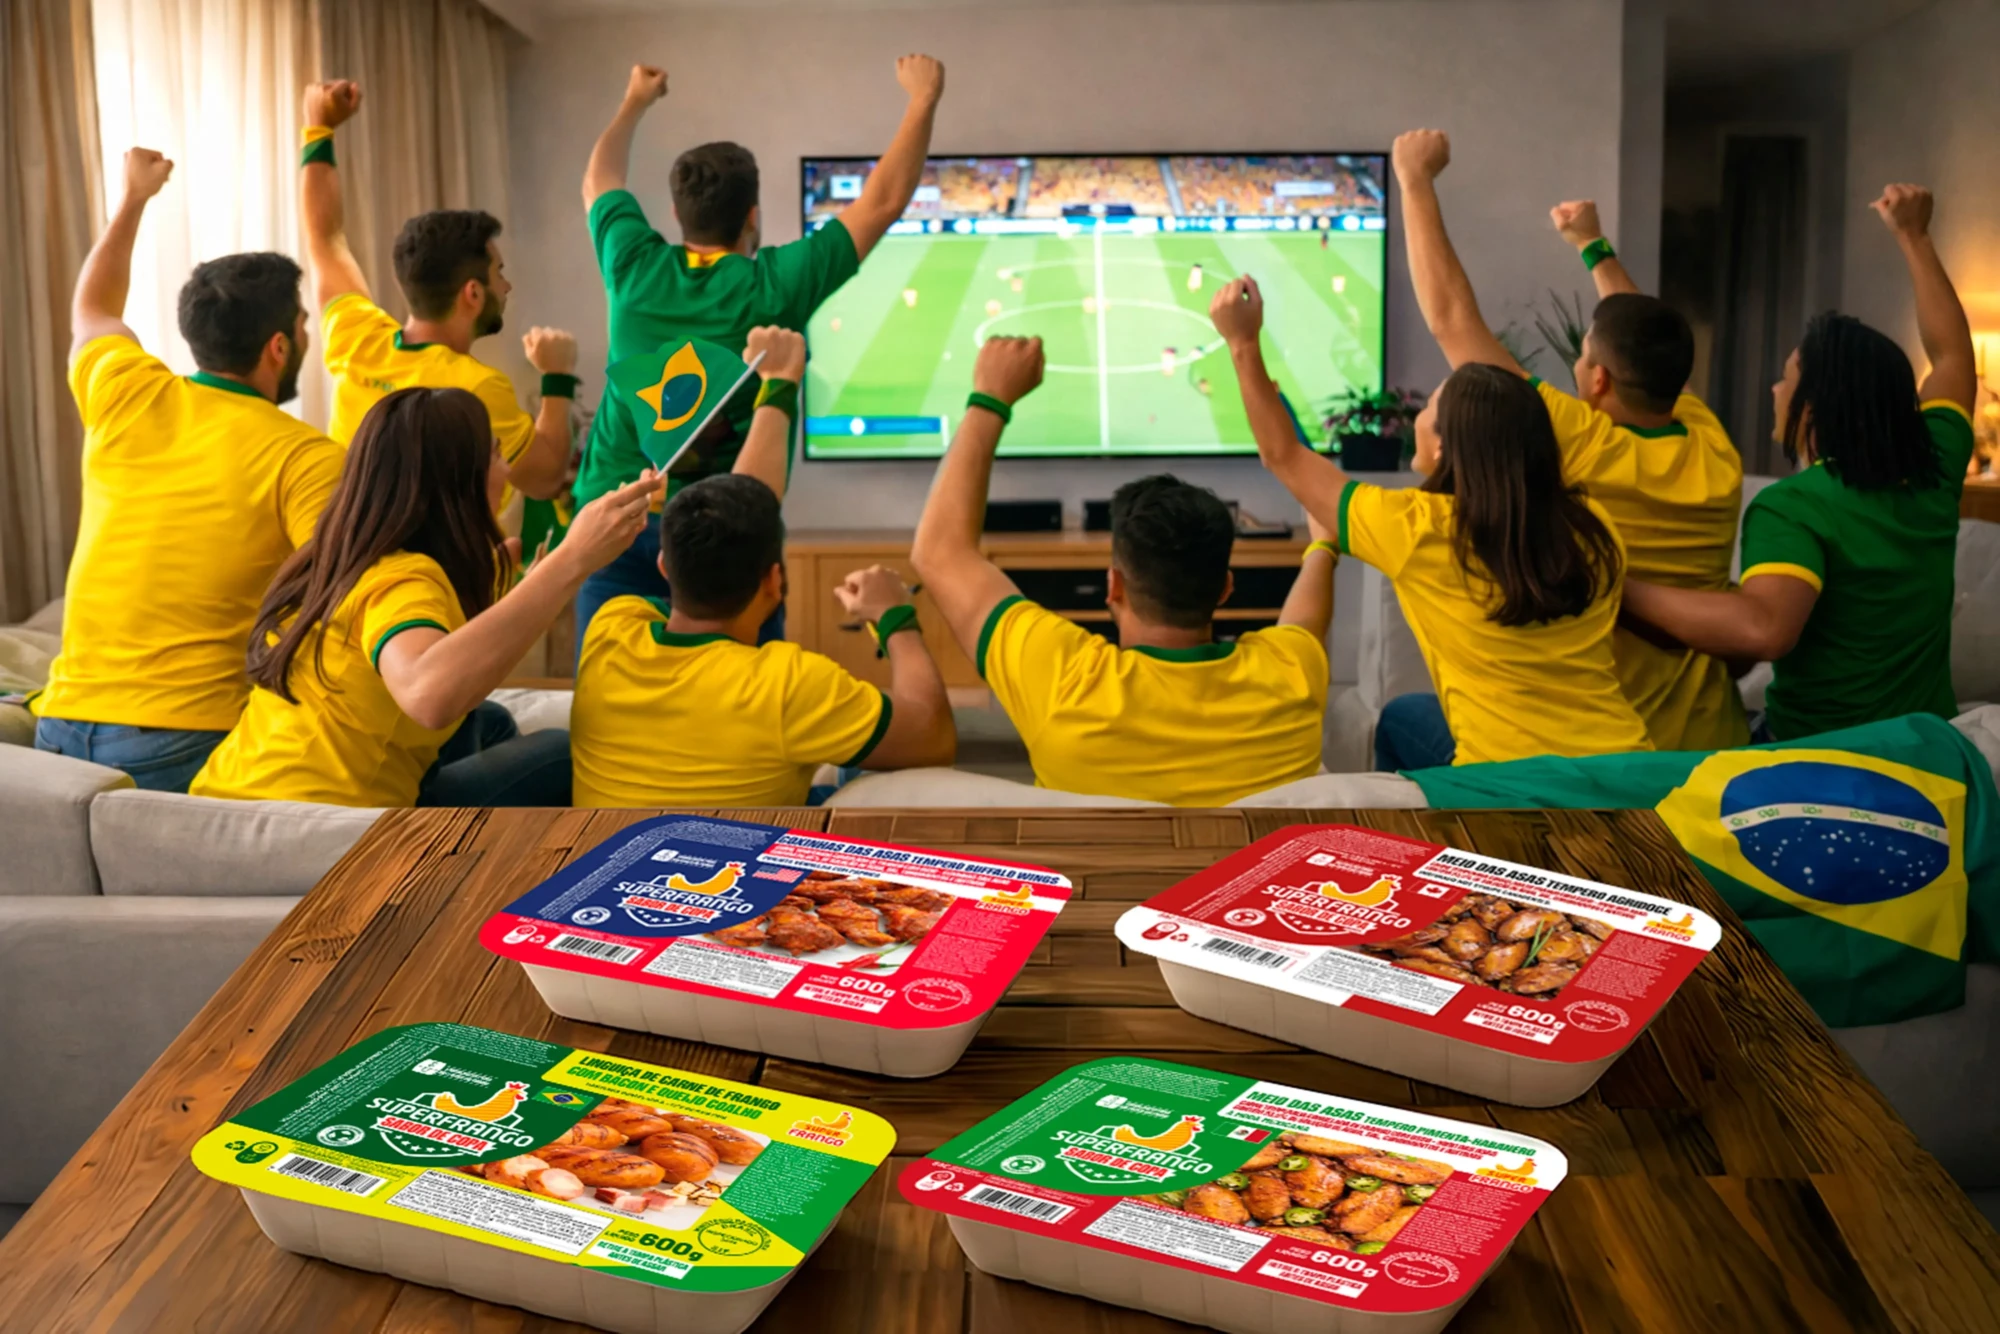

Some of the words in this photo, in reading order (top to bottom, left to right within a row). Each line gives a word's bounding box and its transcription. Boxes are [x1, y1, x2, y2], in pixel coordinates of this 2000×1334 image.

[778, 836, 842, 852] COXINHAS
[844, 844, 873, 856] DAS
[872, 848, 911, 862] ASAS
[910, 856, 965, 870] TEMPERO
[964, 864, 1017, 878] BUFFALO
[1016, 871, 1060, 885] WINGS
[613, 881, 754, 914] SUPERFRANGO
[1436, 854, 1476, 868] MEIO
[1475, 862, 1506, 876] DAS
[1505, 870, 1547, 886] ASAS
[1546, 881, 1607, 900] TEMPERO
[1606, 894, 1672, 916] AGRIDOCE
[625, 896, 667, 911] SABOR
[665, 903, 681, 914] DE
[680, 906, 717, 920] COPA
[975, 902, 1030, 916] FRANGO
[1260, 884, 1412, 928] SUPERFRANGO
[1277, 901, 1318, 918] SABOR
[1317, 909, 1334, 920] DE
[1334, 912, 1371, 930] COPA
[1642, 926, 1692, 942] FRANGO
[1655, 922, 1688, 934] SUPER
[838, 976, 897, 998] 600g
[1507, 1005, 1567, 1030] 600g
[567, 1066, 606, 1080] COM
[599, 1072, 649, 1091] BACON
[646, 1084, 660, 1094] E
[656, 1086, 708, 1106] QUEIJO
[706, 1100, 762, 1120] COALHO
[579, 1056, 642, 1078] LINGUIÇA
[640, 1071, 661, 1082] DE
[659, 1075, 707, 1093] CARNE
[705, 1086, 725, 1098] DE
[723, 1092, 782, 1112] FRANGO
[366, 1098, 534, 1148] SUPERFRANGO
[380, 1116, 430, 1138] SABOR
[426, 1128, 450, 1142] DE
[447, 1132, 490, 1152] COPA
[804, 1124, 841, 1136] SUPER
[1246, 1091, 1288, 1106] MEIO
[1287, 1100, 1322, 1112] DAS
[1320, 1106, 1366, 1122] ASAS
[1364, 1115, 1418, 1133] TEMPERO
[1417, 1126, 1537, 1156] PIMENTA-HABANERO
[1261, 1117, 1310, 1132] MEXICANA
[787, 1128, 845, 1148] FRANGO
[1050, 1130, 1214, 1174] SUPERFRANGO
[1063, 1146, 1113, 1168] SABOR
[1109, 1156, 1133, 1170] DE
[1128, 1160, 1170, 1178] COPA
[1468, 1174, 1534, 1193] FRANGO
[1486, 1170, 1527, 1184] SUPER
[639, 1232, 704, 1262] 600g
[1310, 1250, 1380, 1278] 600g
